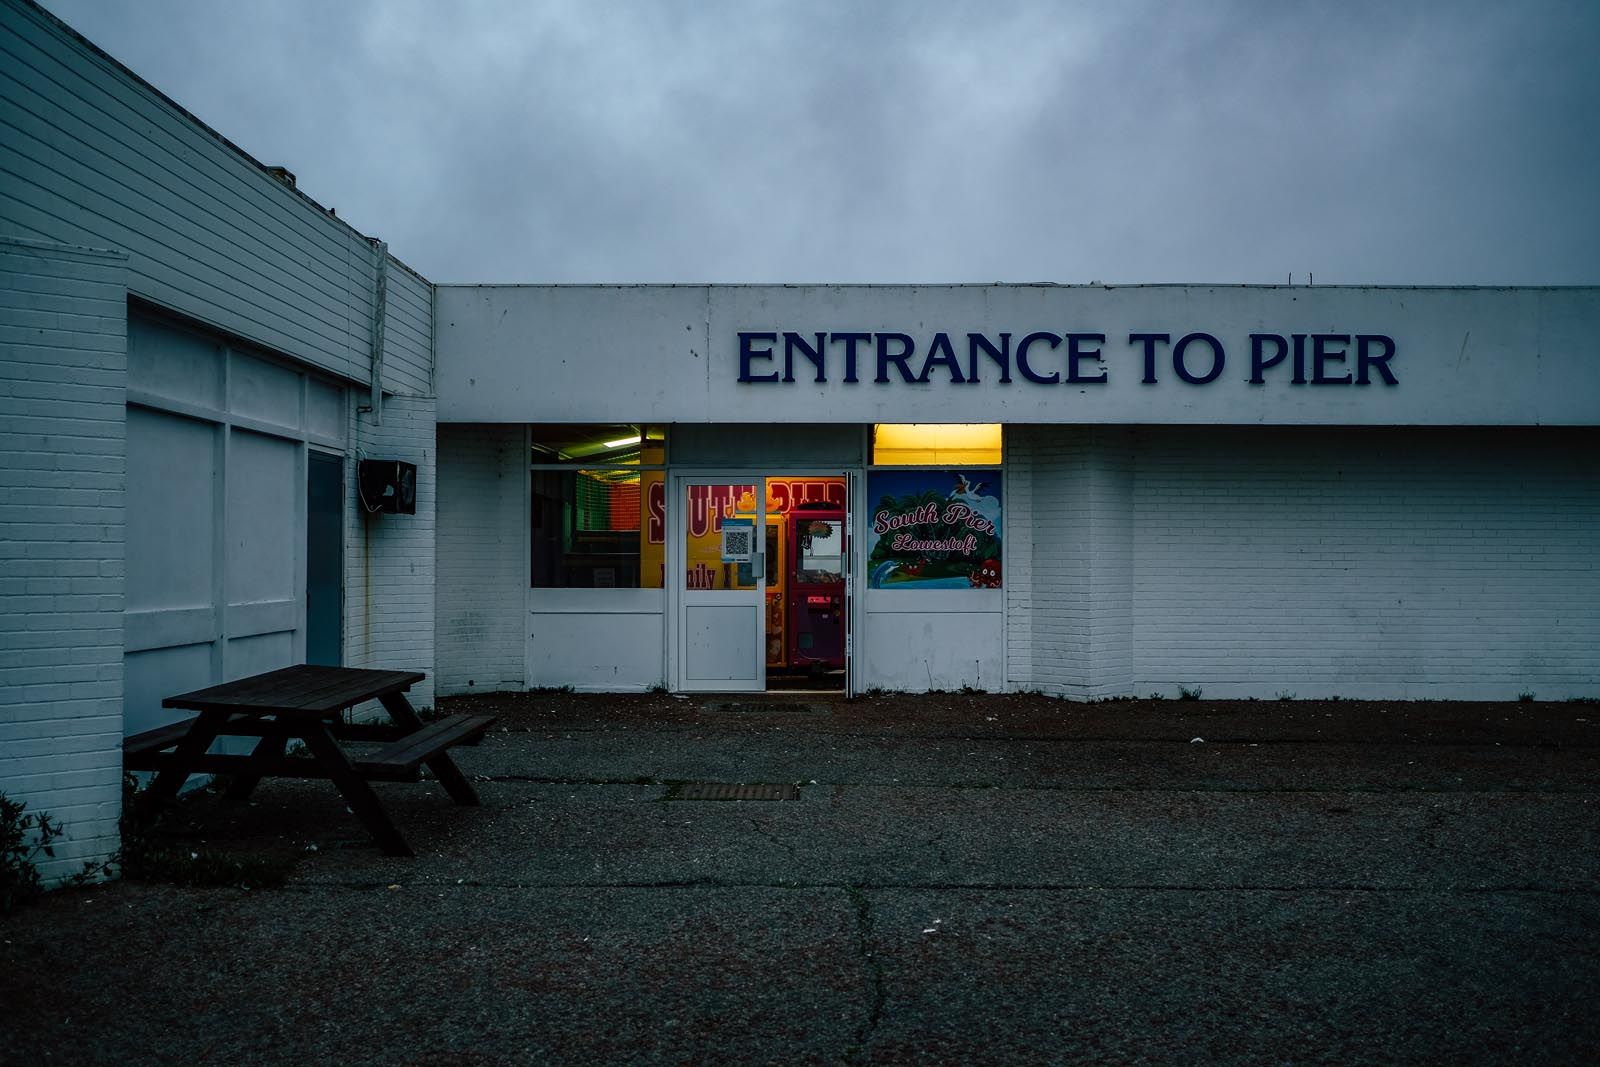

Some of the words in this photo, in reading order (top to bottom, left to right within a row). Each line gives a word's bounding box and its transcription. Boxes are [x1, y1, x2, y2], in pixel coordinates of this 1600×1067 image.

[737, 331, 1108, 385] ENTRANCE
[1129, 332, 1226, 385] TO
[1248, 332, 1399, 386] PIER
[873, 502, 939, 535] South
[942, 502, 996, 536] Pier
[891, 533, 978, 555] Lowestoft
